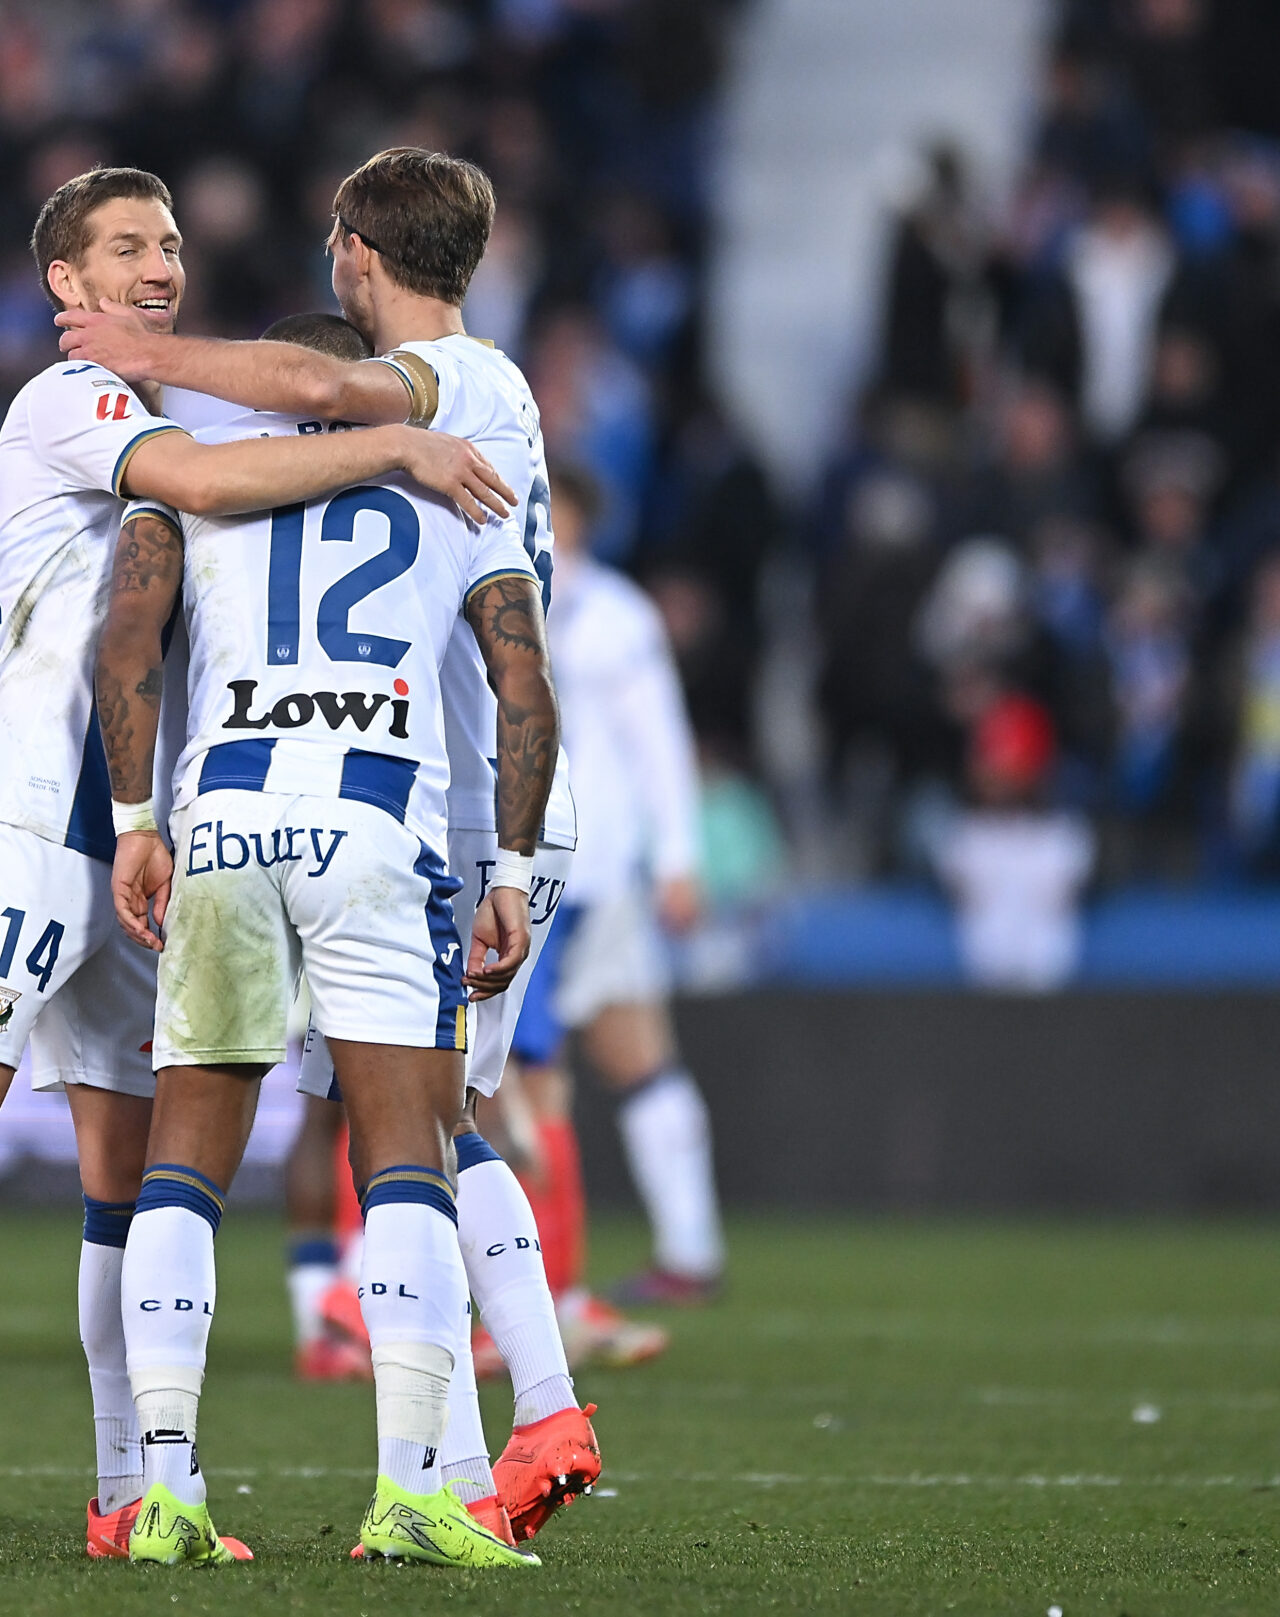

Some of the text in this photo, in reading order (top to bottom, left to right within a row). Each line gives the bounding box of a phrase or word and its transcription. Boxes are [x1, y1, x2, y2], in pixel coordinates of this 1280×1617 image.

[267, 485, 420, 669] 12
[222, 678, 410, 739] Lowi
[186, 821, 348, 878] Ebury
[476, 860, 566, 925] Ery
